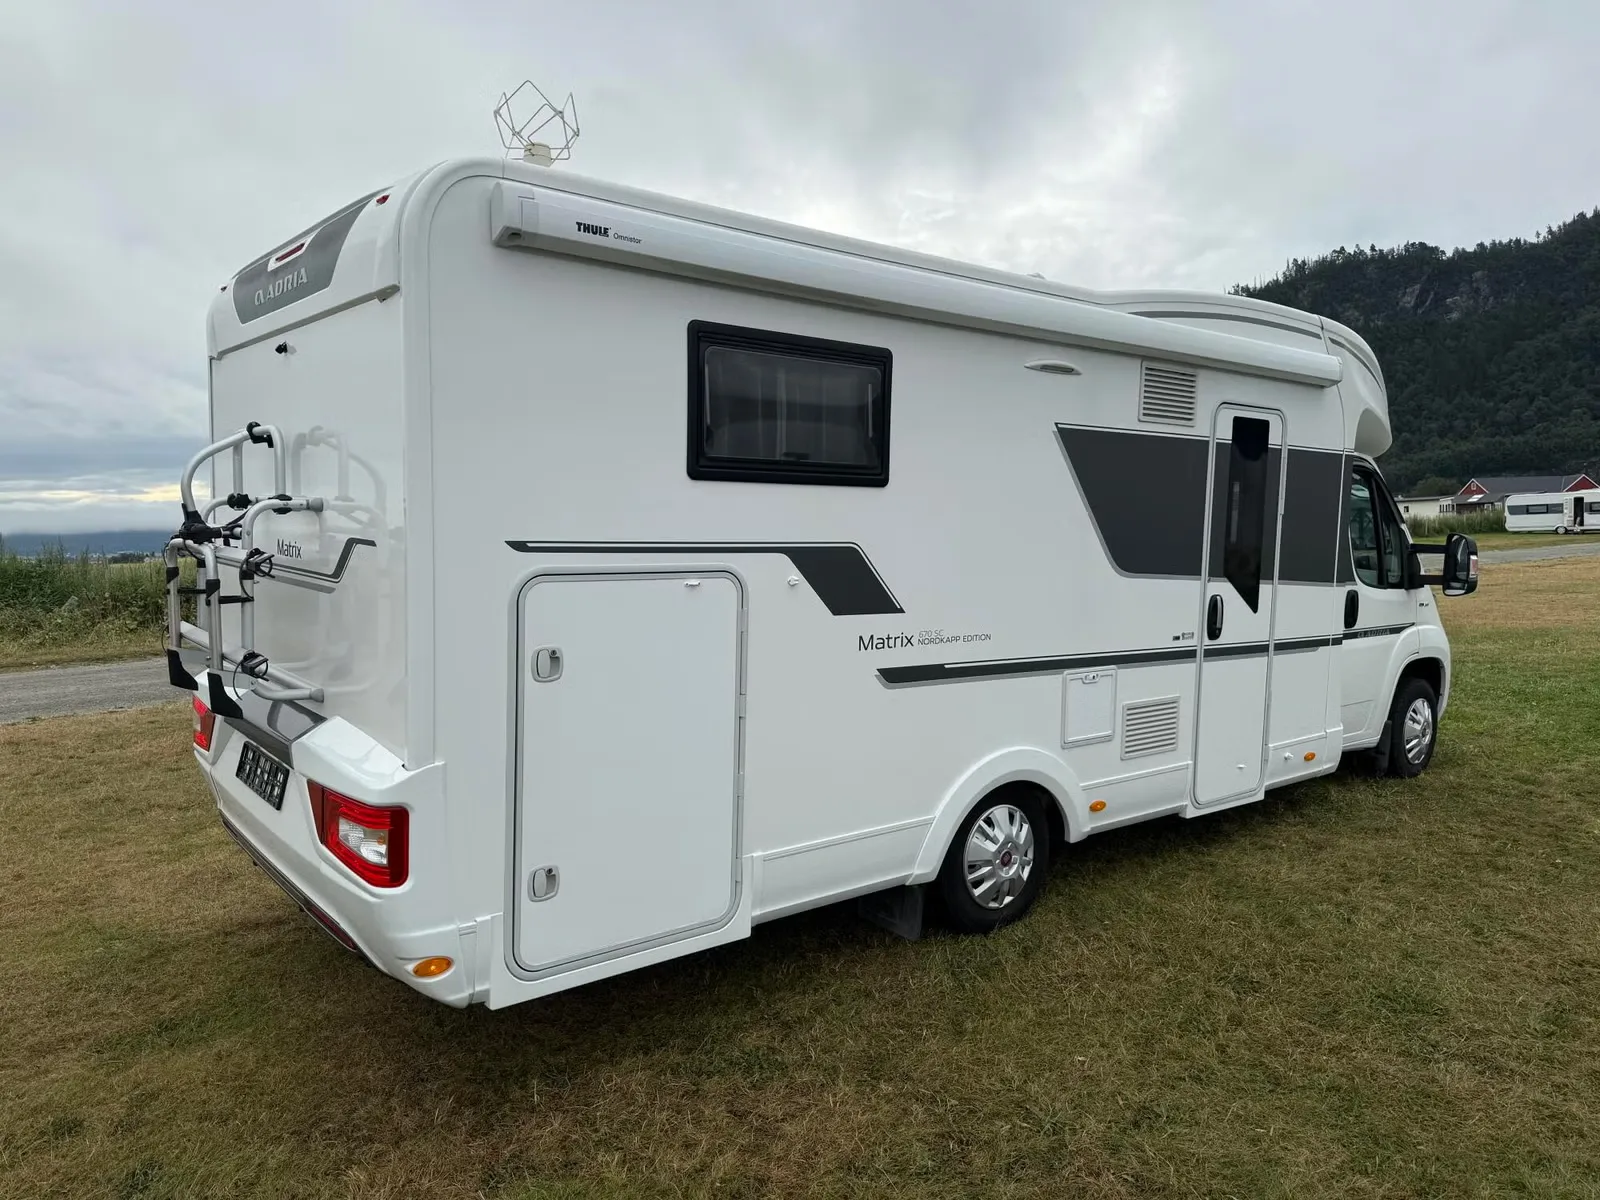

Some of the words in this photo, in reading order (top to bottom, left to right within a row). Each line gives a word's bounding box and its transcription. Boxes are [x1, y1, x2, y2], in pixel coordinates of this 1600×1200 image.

[576, 221, 610, 238] THULE
[613, 232, 642, 244] Omnistor
[266, 267, 308, 302] ADRIA
[277, 538, 303, 559] Matrix
[858, 632, 914, 651] Matrix
[918, 630, 932, 638] 670
[934, 629, 944, 637] SC
[918, 636, 961, 645] NORDKAPP
[962, 633, 991, 642] EDITION
